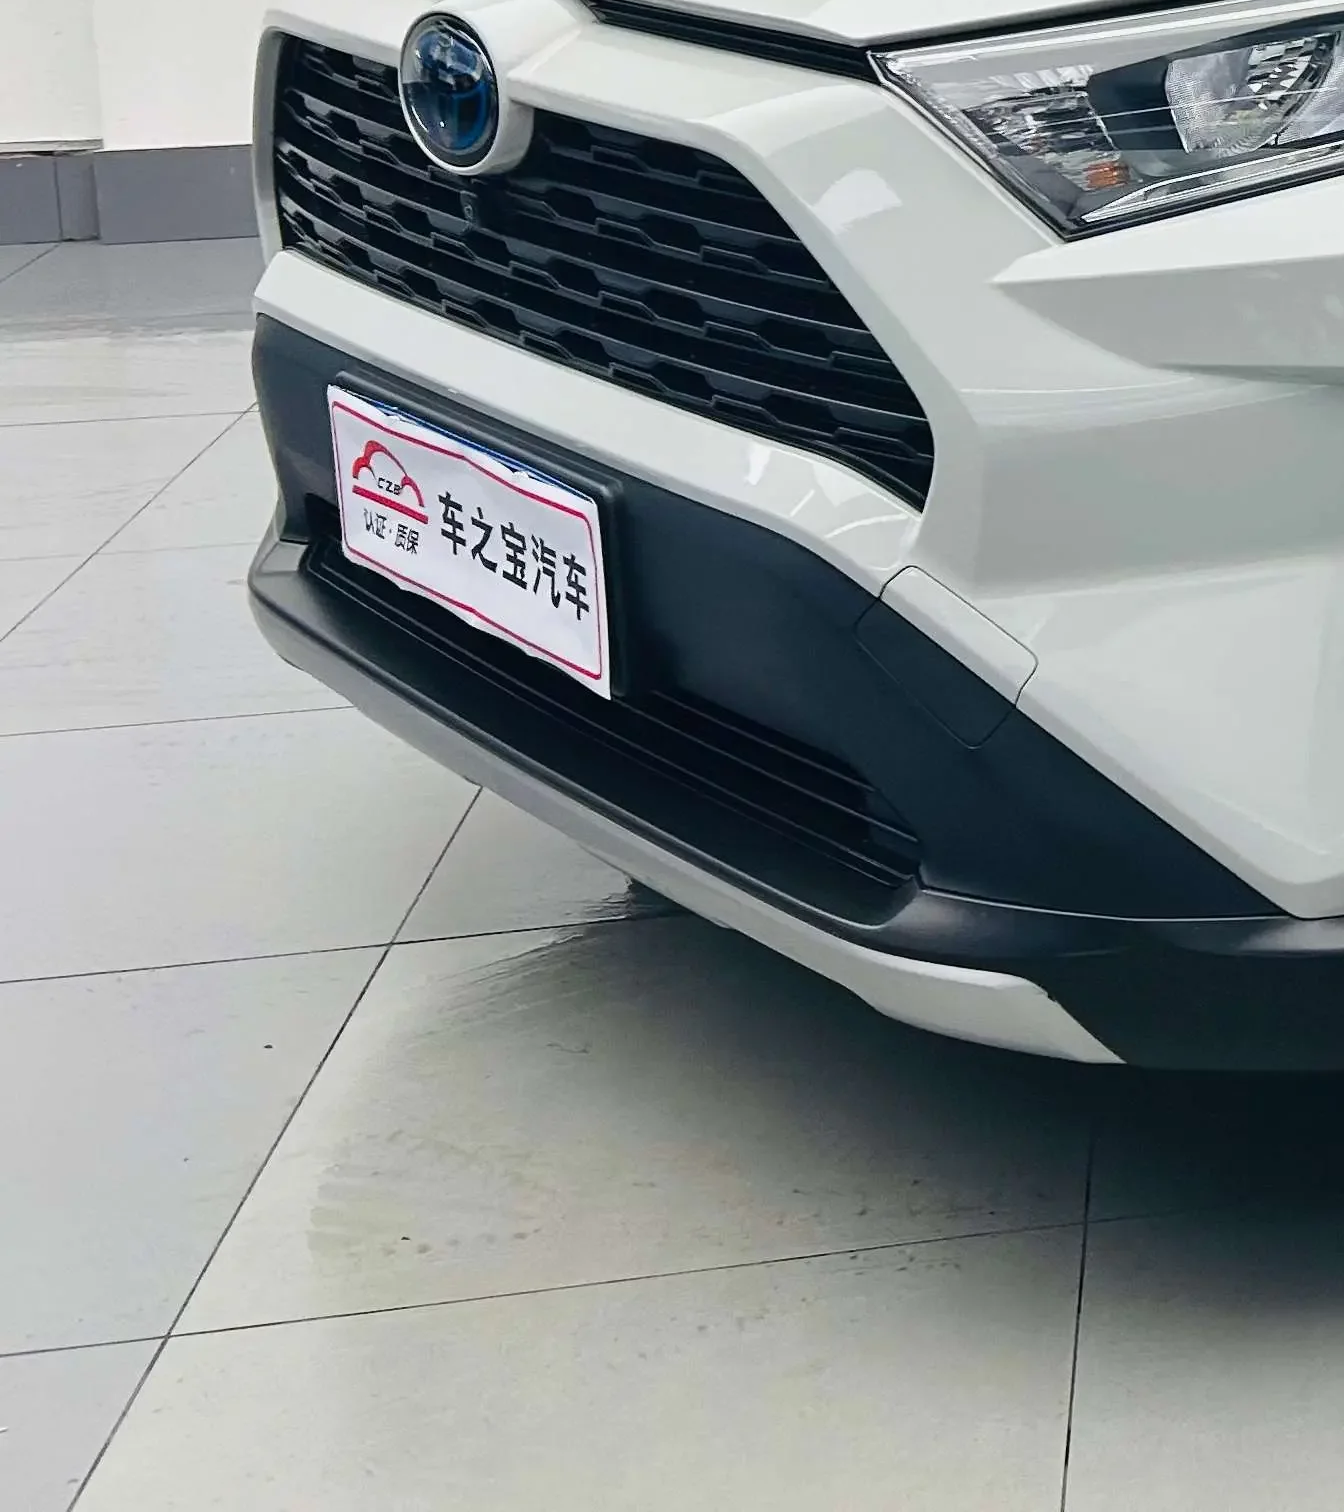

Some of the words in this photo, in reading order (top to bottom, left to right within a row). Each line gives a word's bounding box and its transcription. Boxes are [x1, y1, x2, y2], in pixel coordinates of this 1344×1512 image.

[377, 476, 402, 497] CZB
[438, 491, 590, 621] 车之宝汽车
